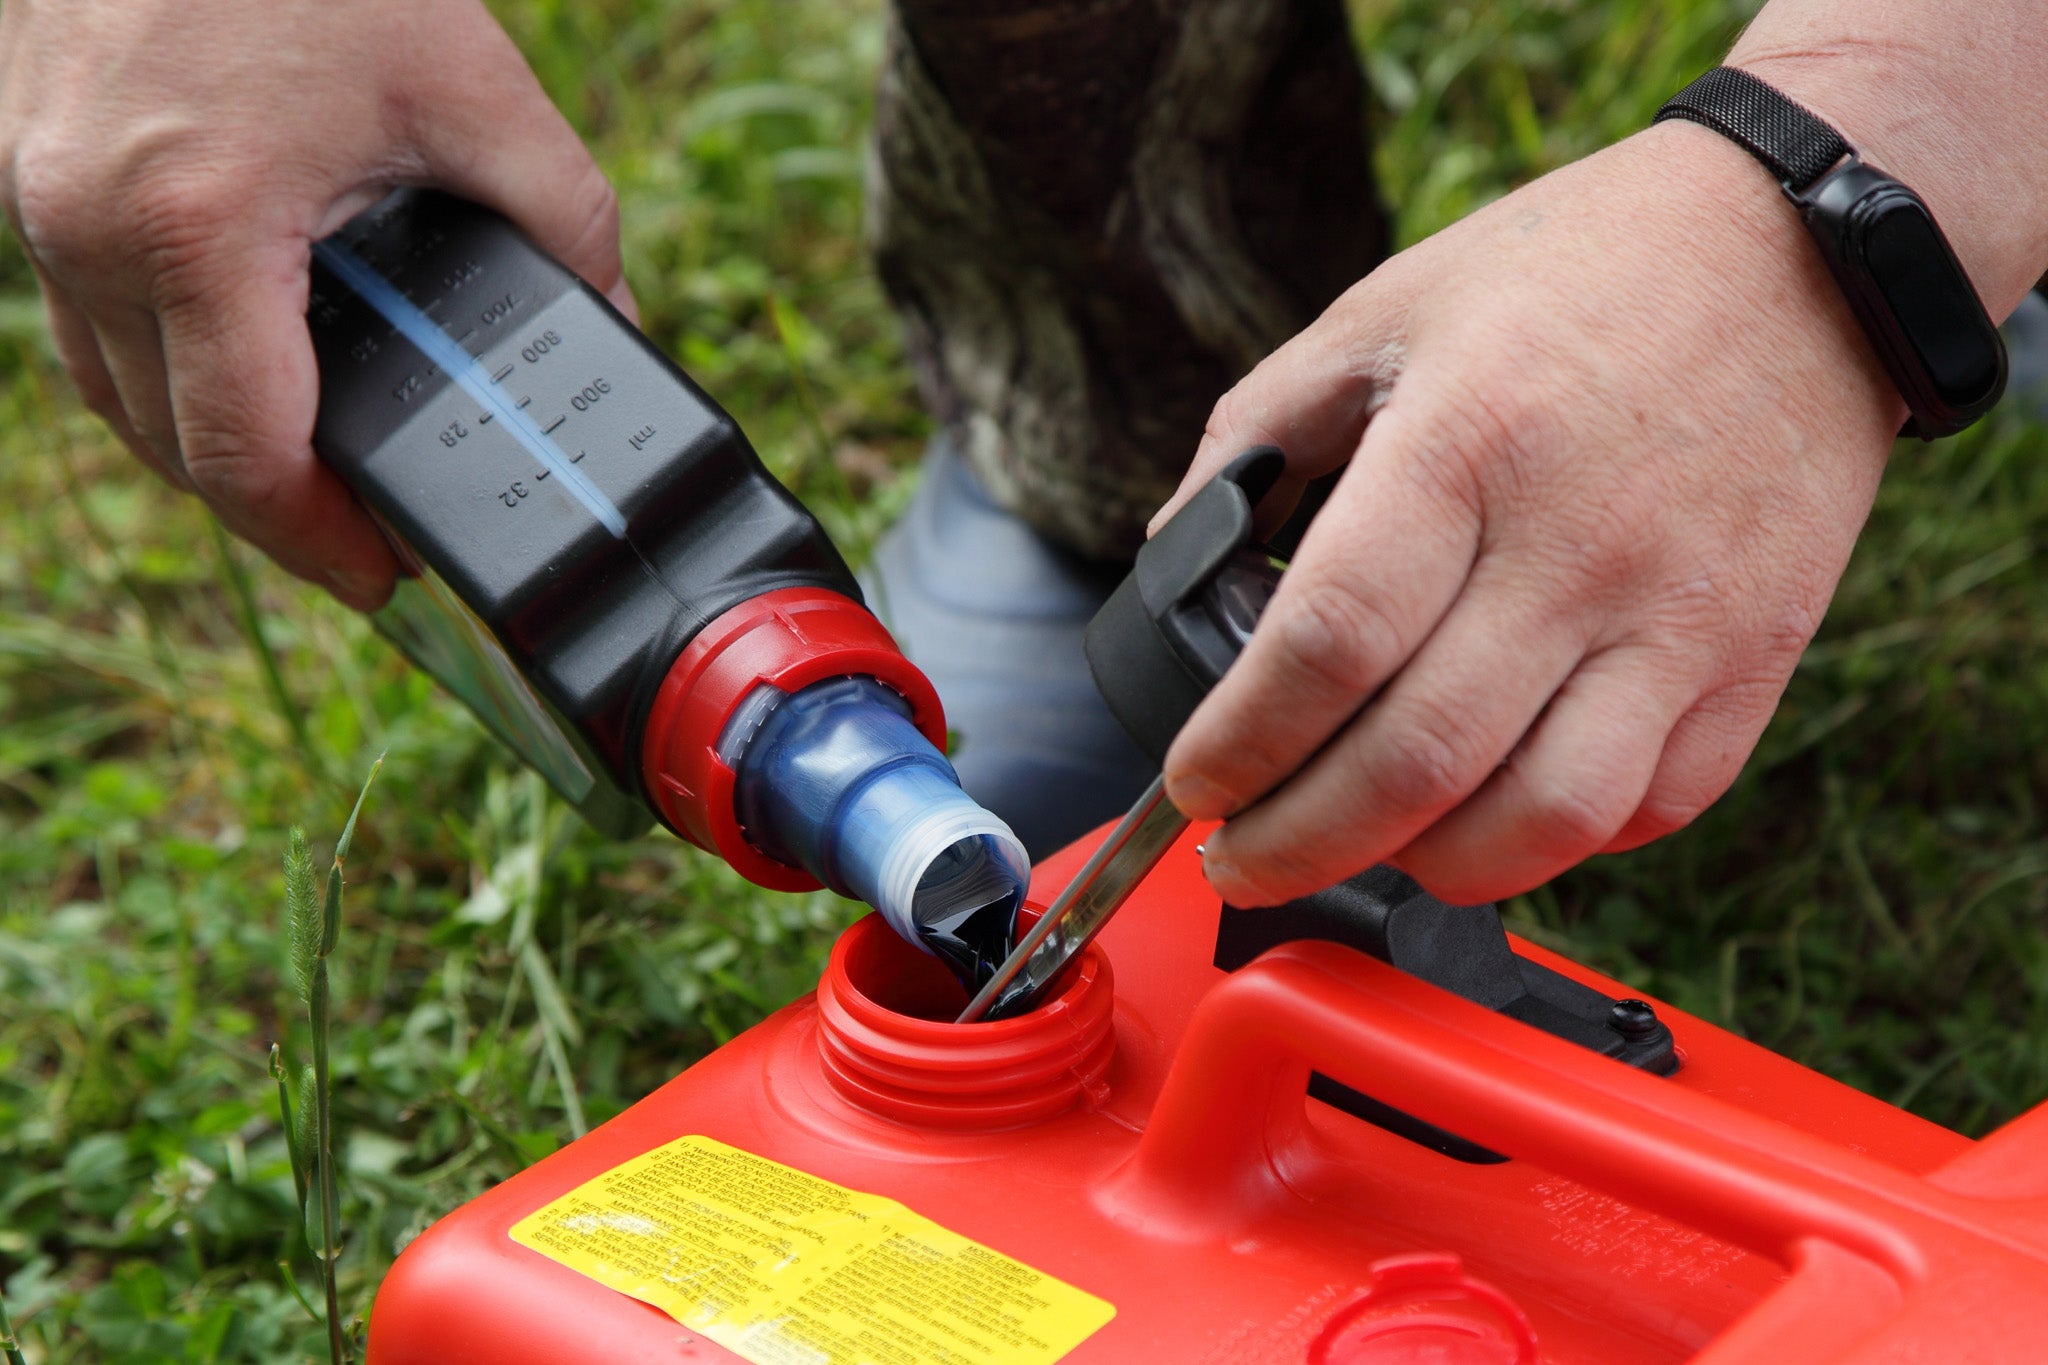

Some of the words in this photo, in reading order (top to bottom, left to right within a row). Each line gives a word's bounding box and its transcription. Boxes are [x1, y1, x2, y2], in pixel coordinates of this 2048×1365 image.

[481, 292, 524, 326] 700
[521, 328, 562, 364] 800
[392, 375, 424, 404] 24
[571, 376, 612, 412] 900
[438, 418, 469, 449] 28
[628, 423, 657, 452] ml
[497, 480, 530, 509] 32
[651, 1162, 705, 1185] OPERATION
[715, 1187, 757, 1206] REDUCE
[753, 1202, 777, 1214] THE
[662, 1158, 688, 1170] TANK
[721, 1181, 768, 1202] SECURED
[764, 1198, 804, 1217] DURING
[669, 1154, 704, 1169] STORE
[710, 1169, 739, 1182] WELL
[735, 1179, 792, 1203] VENTILATED
[679, 1150, 707, 1162] SAFE
[703, 1159, 725, 1169] FILL
[721, 1166, 753, 1180] LEVEL
[762, 1181, 813, 1203] INDICATED
[844, 1209, 870, 1222] TANK
[729, 1151, 784, 1174] OPERATING
[781, 1170, 851, 1199] INSTRUCTIONS
[752, 1170, 774, 1180] NOT
[815, 1193, 836, 1204] FILL
[603, 1186, 644, 1204] BEFORE
[639, 1200, 687, 1223] STARTING
[609, 1199, 685, 1234] MAINTENANCE
[614, 1181, 662, 1202] MANUALLY
[659, 1199, 699, 1218] VENTED
[695, 1215, 724, 1230] CAPS
[720, 1226, 751, 1242] MUST
[623, 1176, 665, 1194] REMOVE
[662, 1191, 688, 1204] TANK
[685, 1200, 716, 1216] FROM
[711, 1212, 740, 1227] BOAT
[736, 1223, 760, 1236] FOR
[641, 1166, 698, 1191] LIKELIHOOD
[707, 1192, 753, 1213] SHIFTING
[748, 1210, 772, 1222] AND
[768, 1218, 830, 1245] MECANICAL
[538, 1224, 565, 1239] WILL
[559, 1234, 589, 1250] GIVE
[582, 1245, 614, 1262] MANY
[575, 1230, 601, 1245] NEW
[597, 1240, 626, 1256] TANK
[630, 1256, 683, 1283] PROPER
[578, 1201, 623, 1221] REPLACE
[727, 1267, 762, 1288] SIGNS
[592, 1227, 623, 1244] OVER
[618, 1239, 662, 1262] TIGHTEN
[964, 1245, 998, 1262] MODE
[705, 1267, 751, 1294] MISSING
